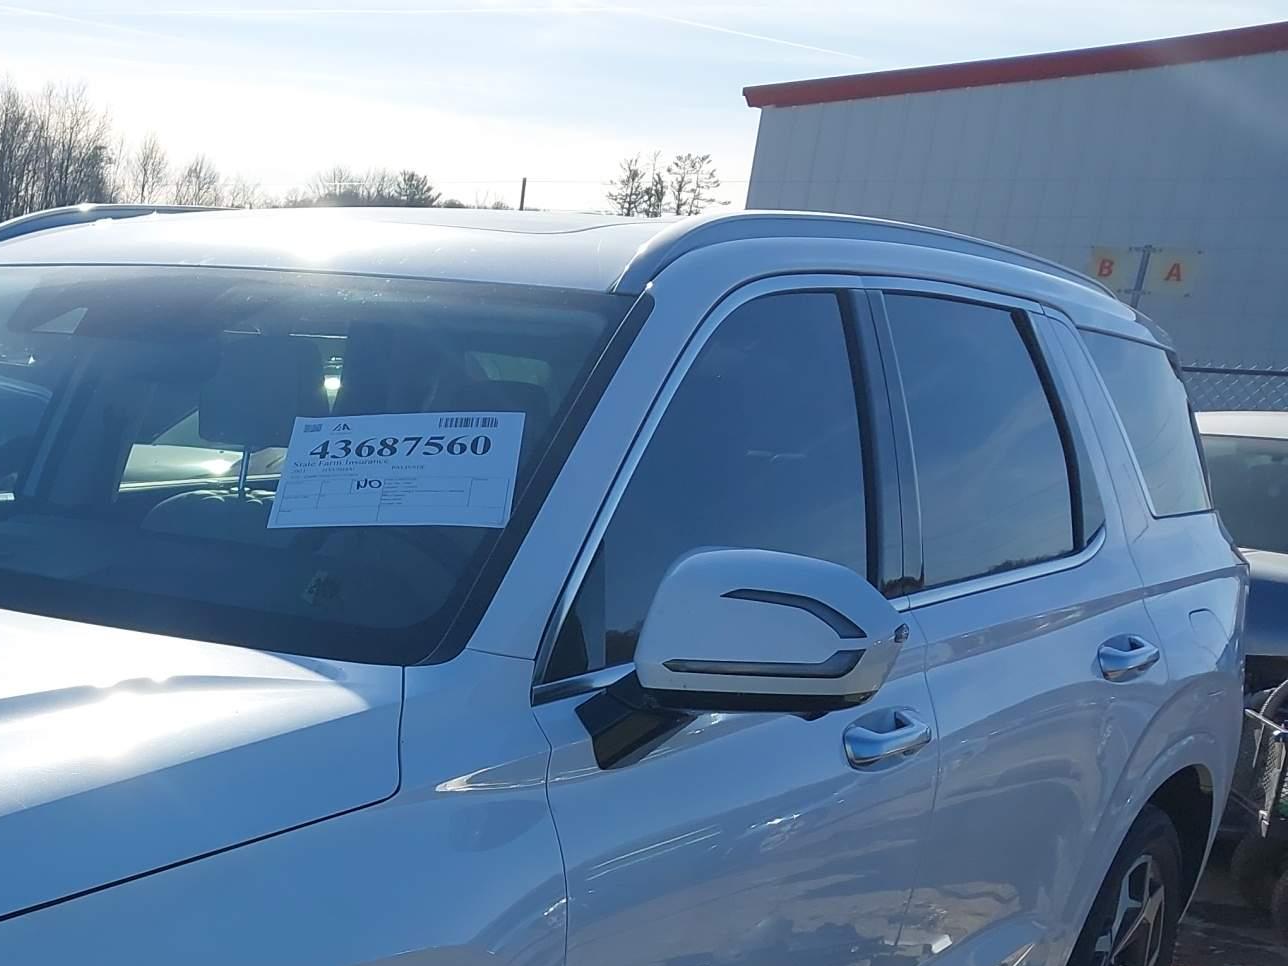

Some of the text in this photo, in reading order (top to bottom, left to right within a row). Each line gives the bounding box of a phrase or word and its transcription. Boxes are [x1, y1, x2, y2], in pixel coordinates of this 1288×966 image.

[1097, 259, 1114, 278] B
[1164, 263, 1182, 282] A
[309, 435, 491, 459] 43687560
